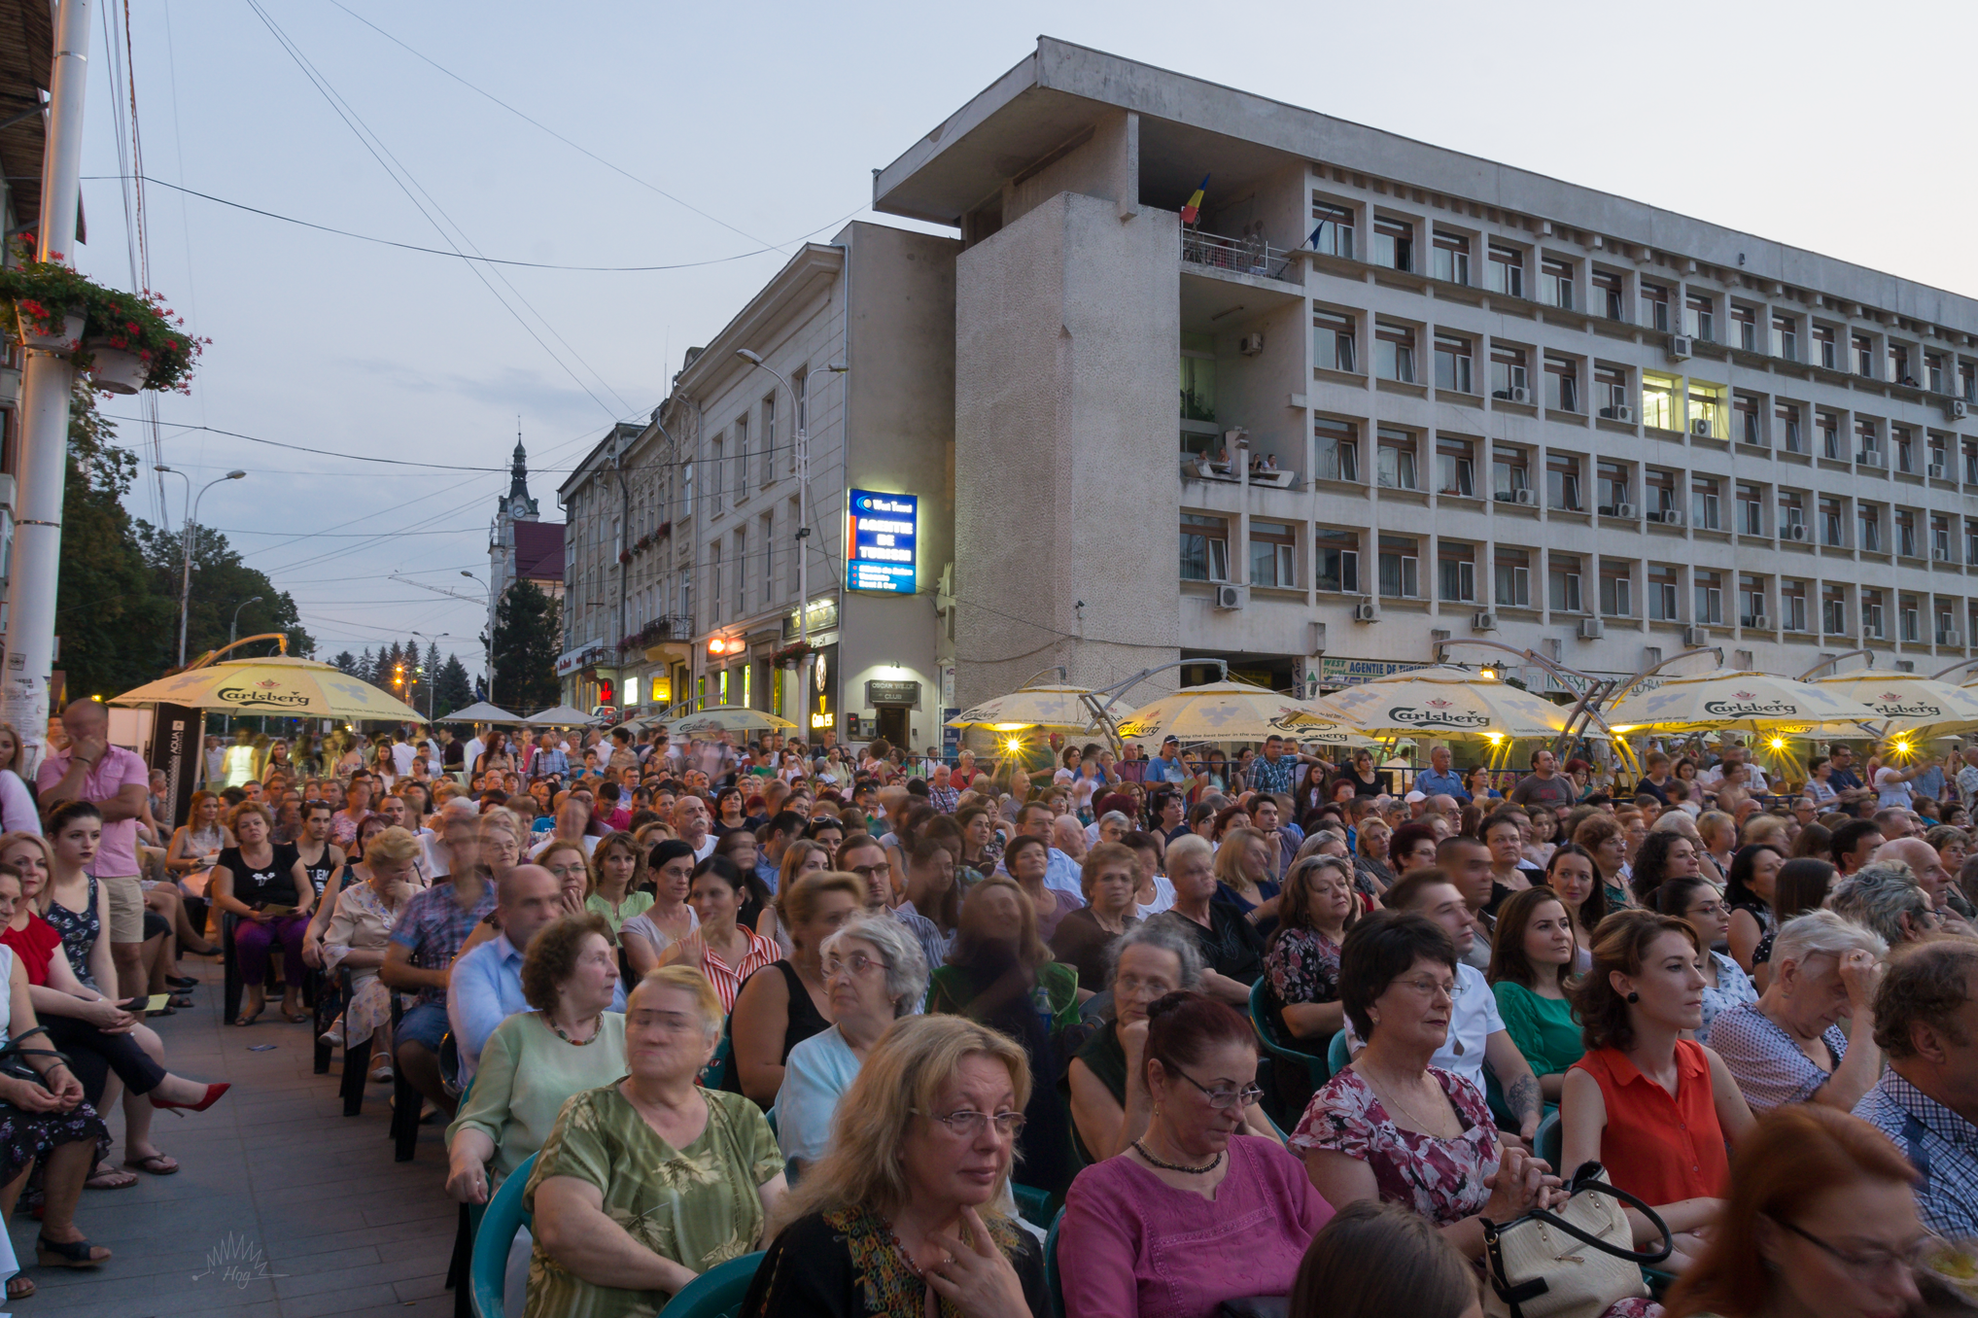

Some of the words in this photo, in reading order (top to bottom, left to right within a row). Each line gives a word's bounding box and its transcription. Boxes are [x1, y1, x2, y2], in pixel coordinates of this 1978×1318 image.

[877, 534, 894, 546] DE
[1323, 659, 1346, 667] WEST
[1349, 662, 1384, 674] AGENTIE
[1386, 664, 1396, 675] DE
[217, 687, 310, 706] Carlsberg
[1704, 700, 1797, 718] Carlsberg
[1388, 706, 1490, 728] Carlsberg
